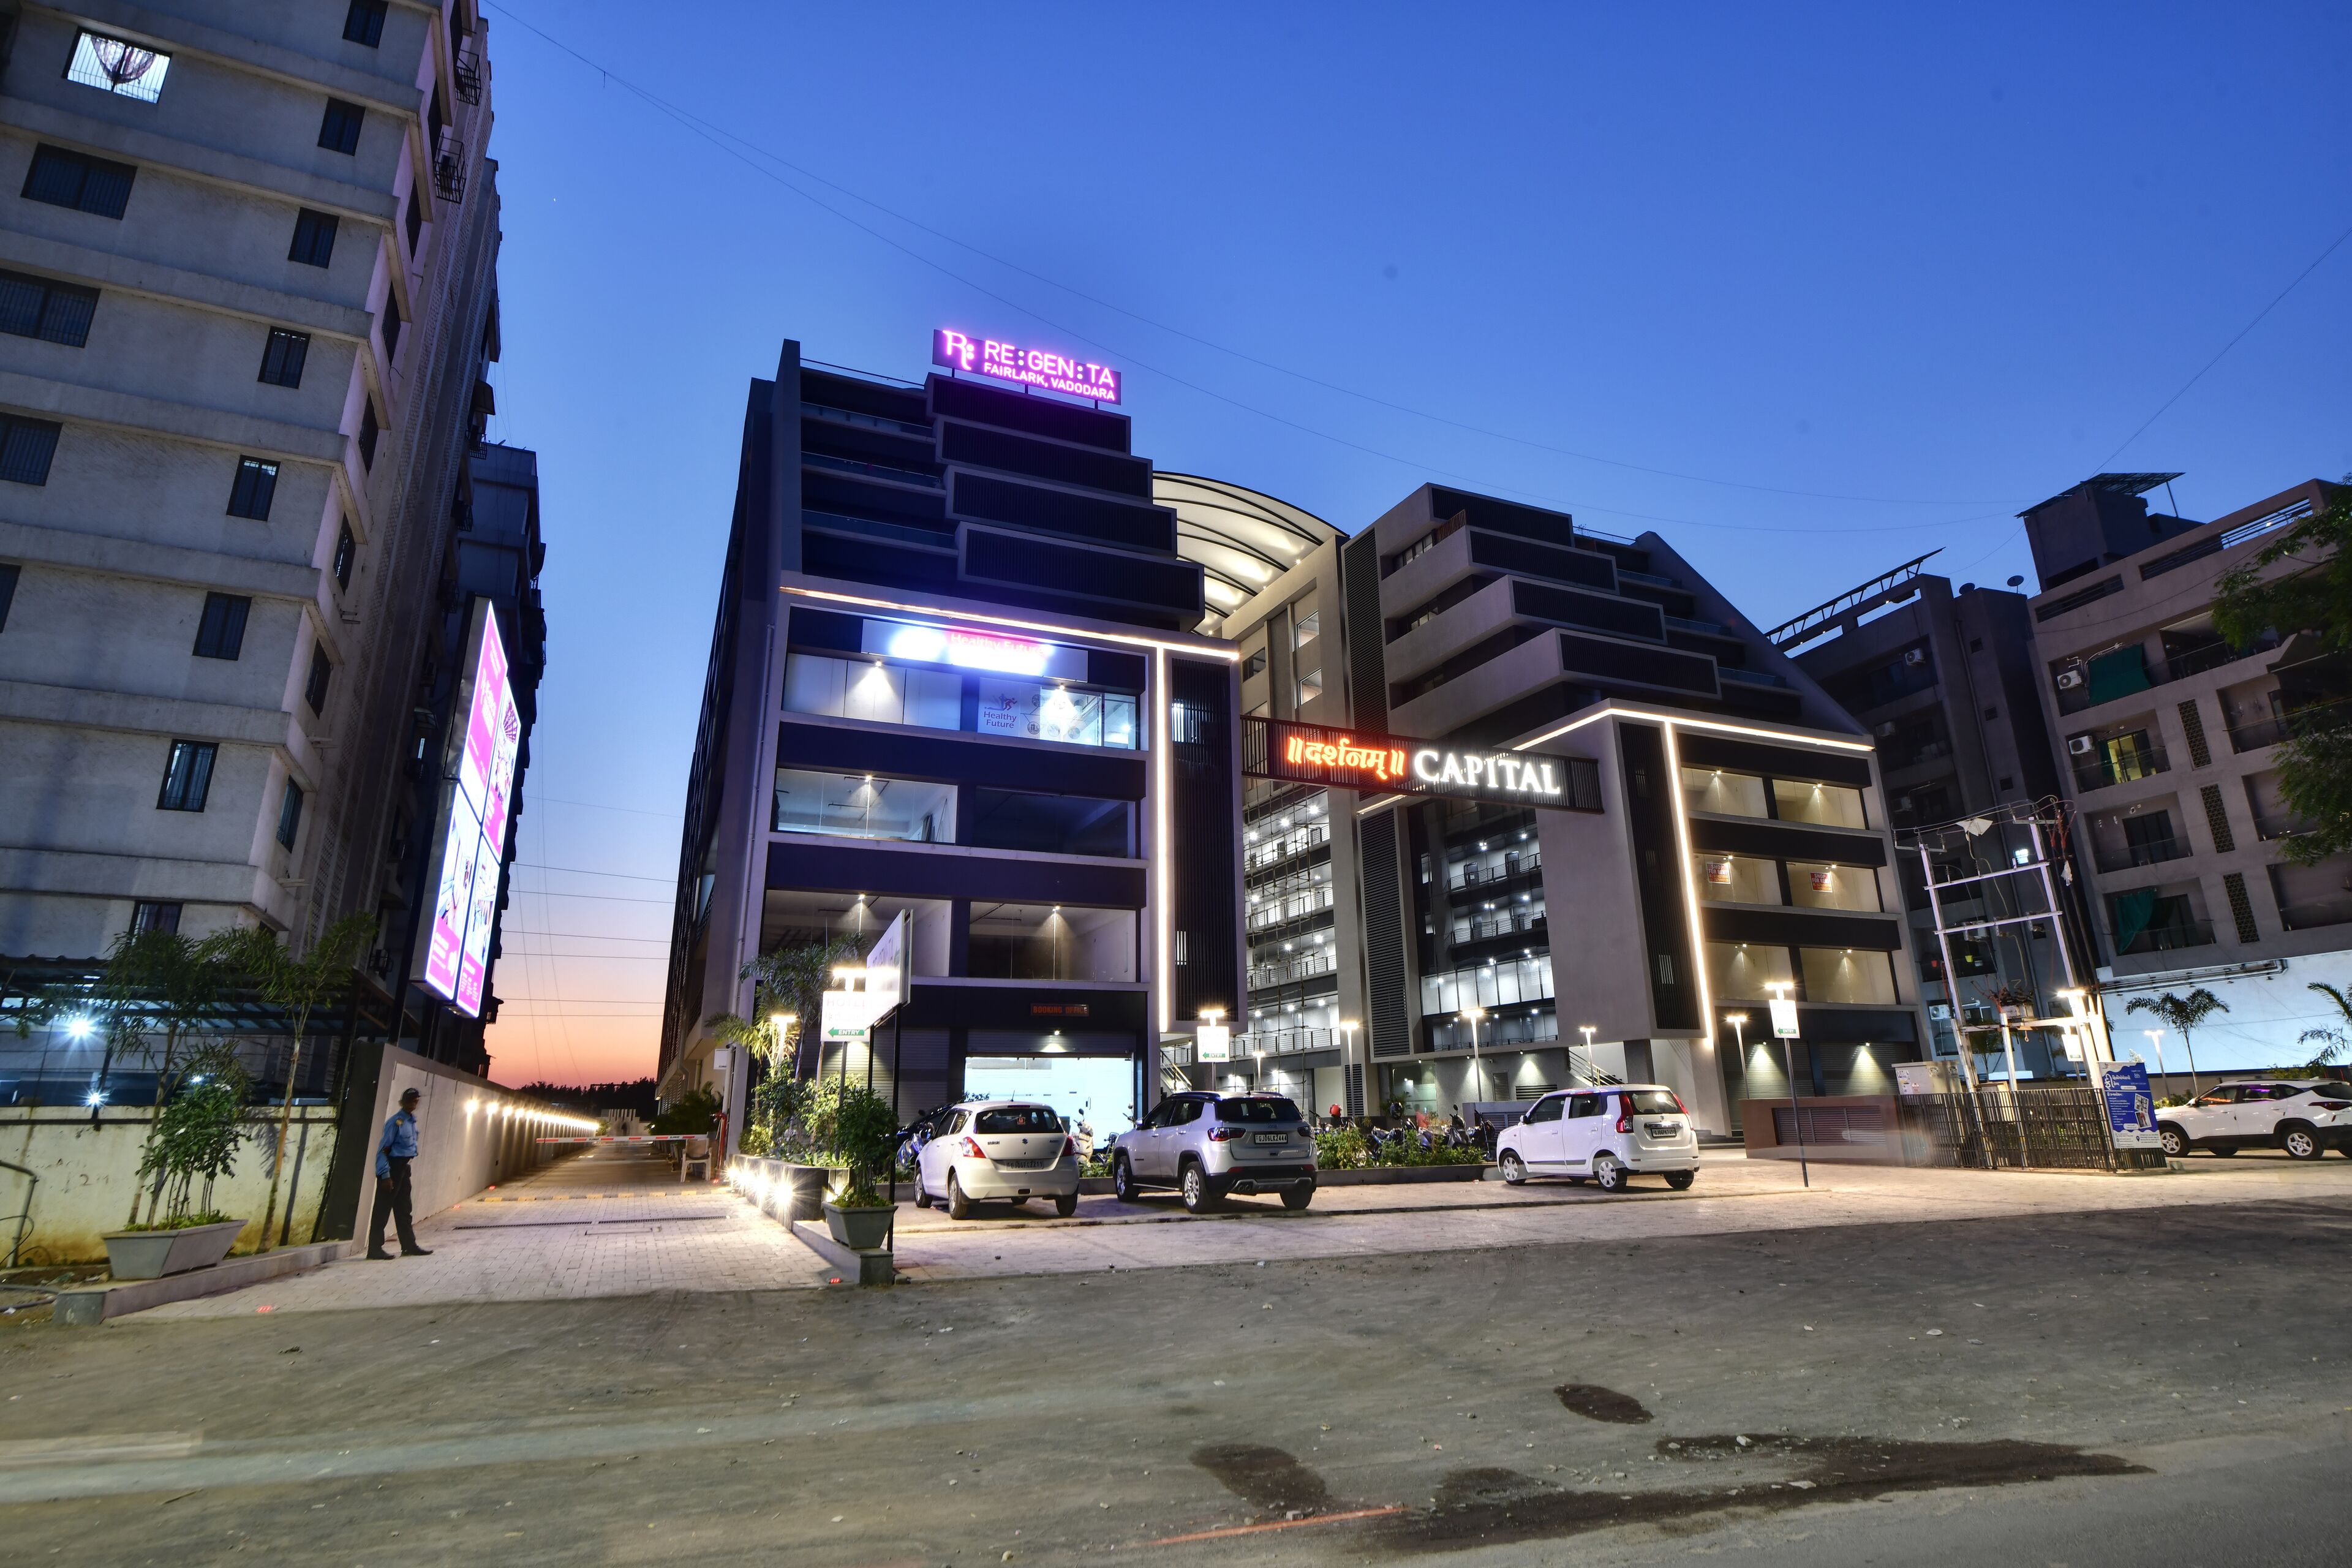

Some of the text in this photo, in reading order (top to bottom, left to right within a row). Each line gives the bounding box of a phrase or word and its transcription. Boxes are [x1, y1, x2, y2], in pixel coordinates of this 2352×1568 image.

[984, 362, 1115, 401] FAIRLARK, VADODARA
[984, 711, 1017, 723] Healthy
[986, 719, 1014, 728] Future
[1414, 750, 1560, 794] CAPITAL
